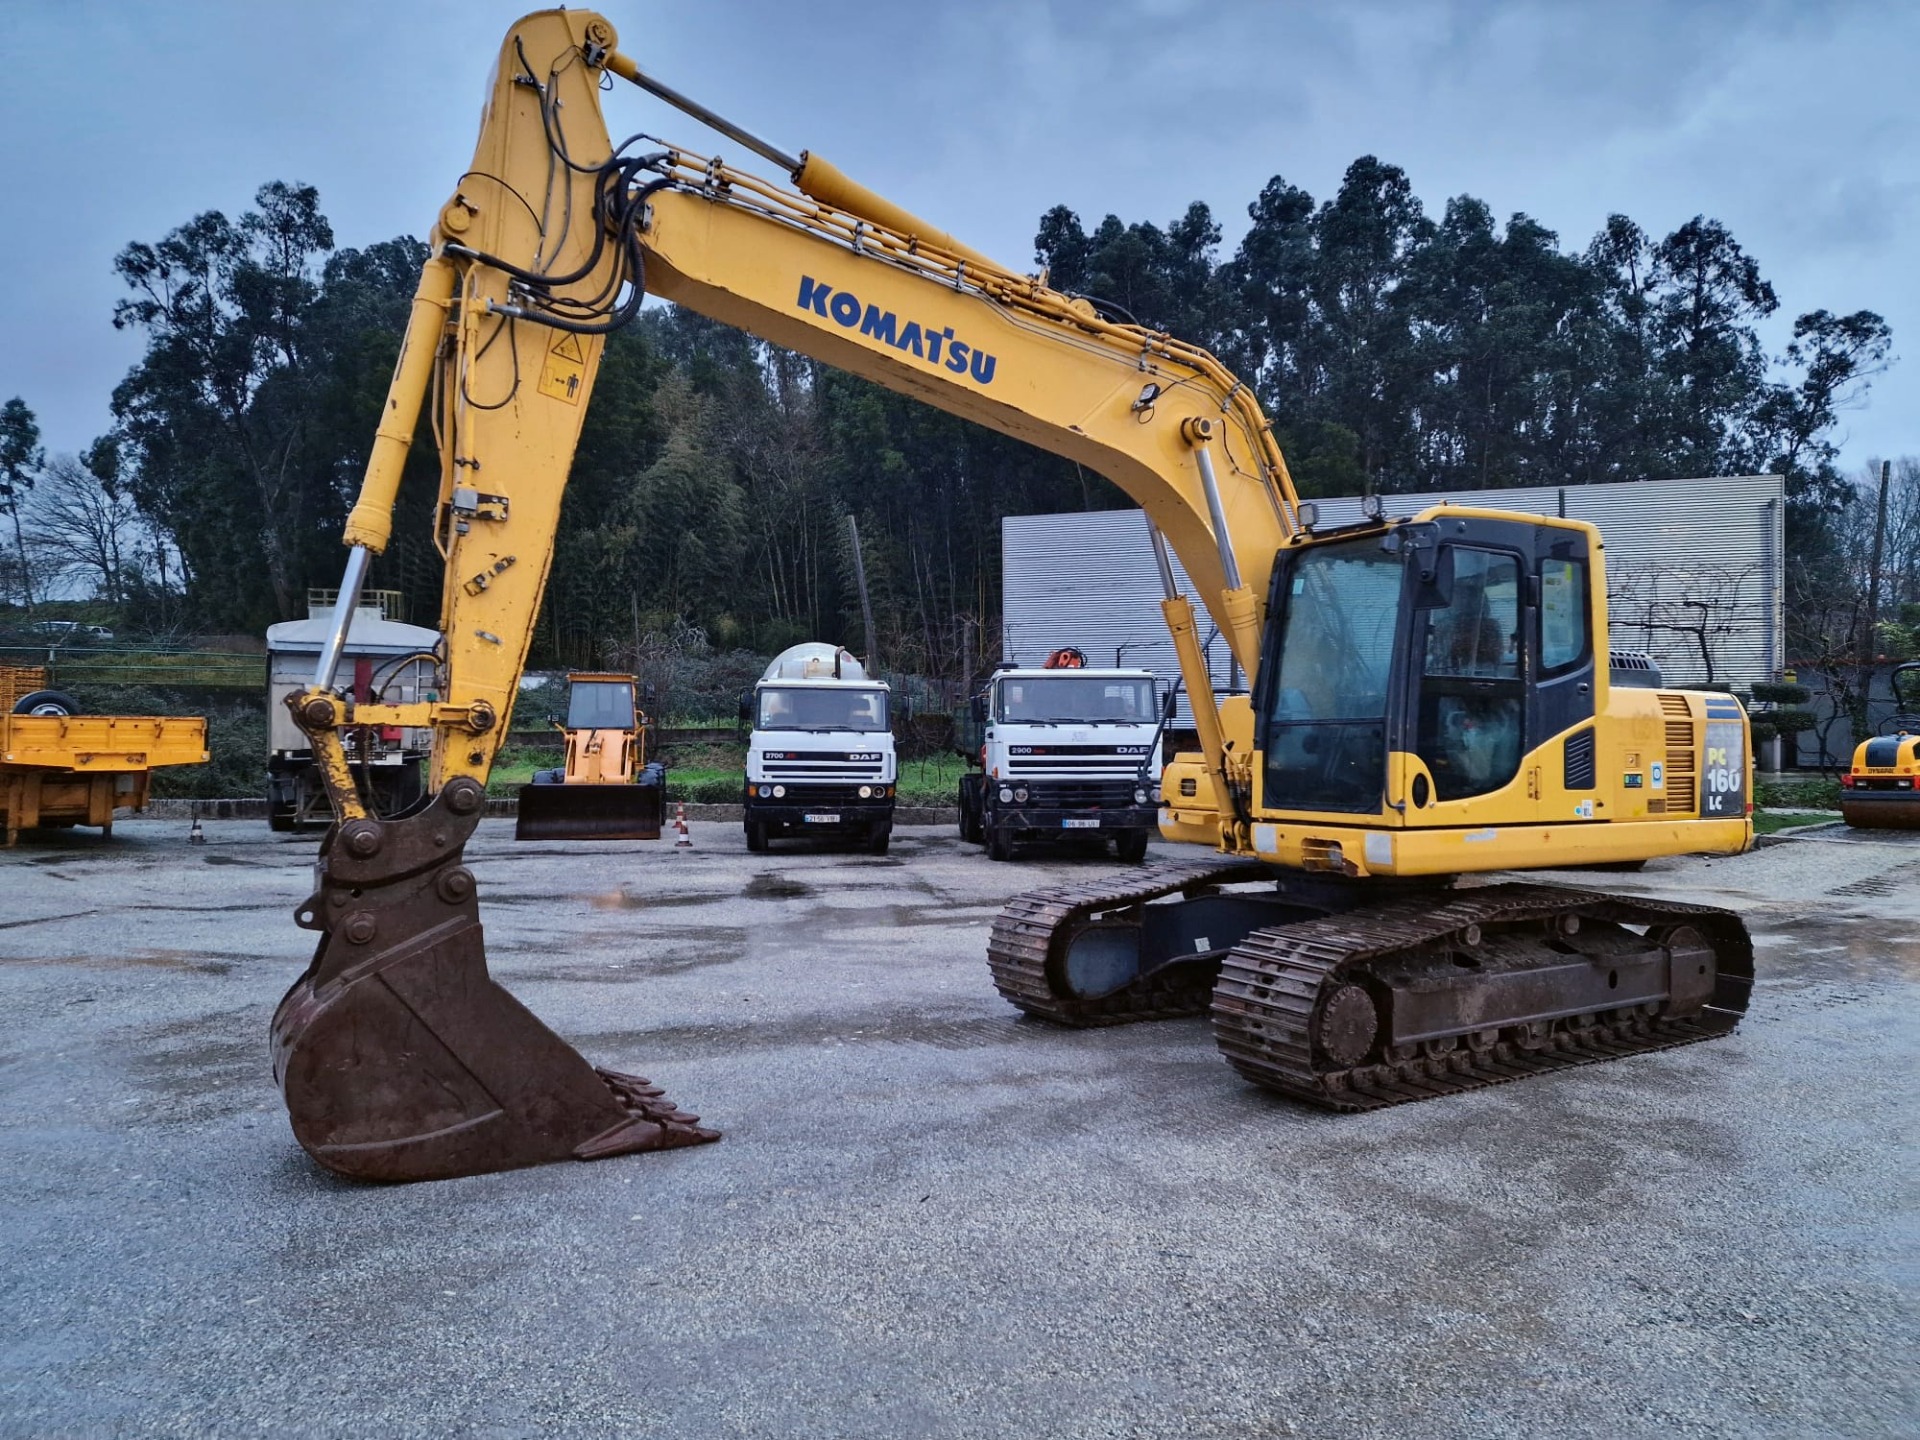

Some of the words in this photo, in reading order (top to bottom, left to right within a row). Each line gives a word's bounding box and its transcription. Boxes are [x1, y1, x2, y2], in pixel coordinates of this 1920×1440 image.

[797, 274, 997, 384] KOMATSU
[765, 752, 784, 760] 2700
[1116, 746, 1149, 754] DAF
[1707, 747, 1727, 766] PC
[1707, 768, 1741, 793] 160
[1708, 795, 1723, 811] LC
